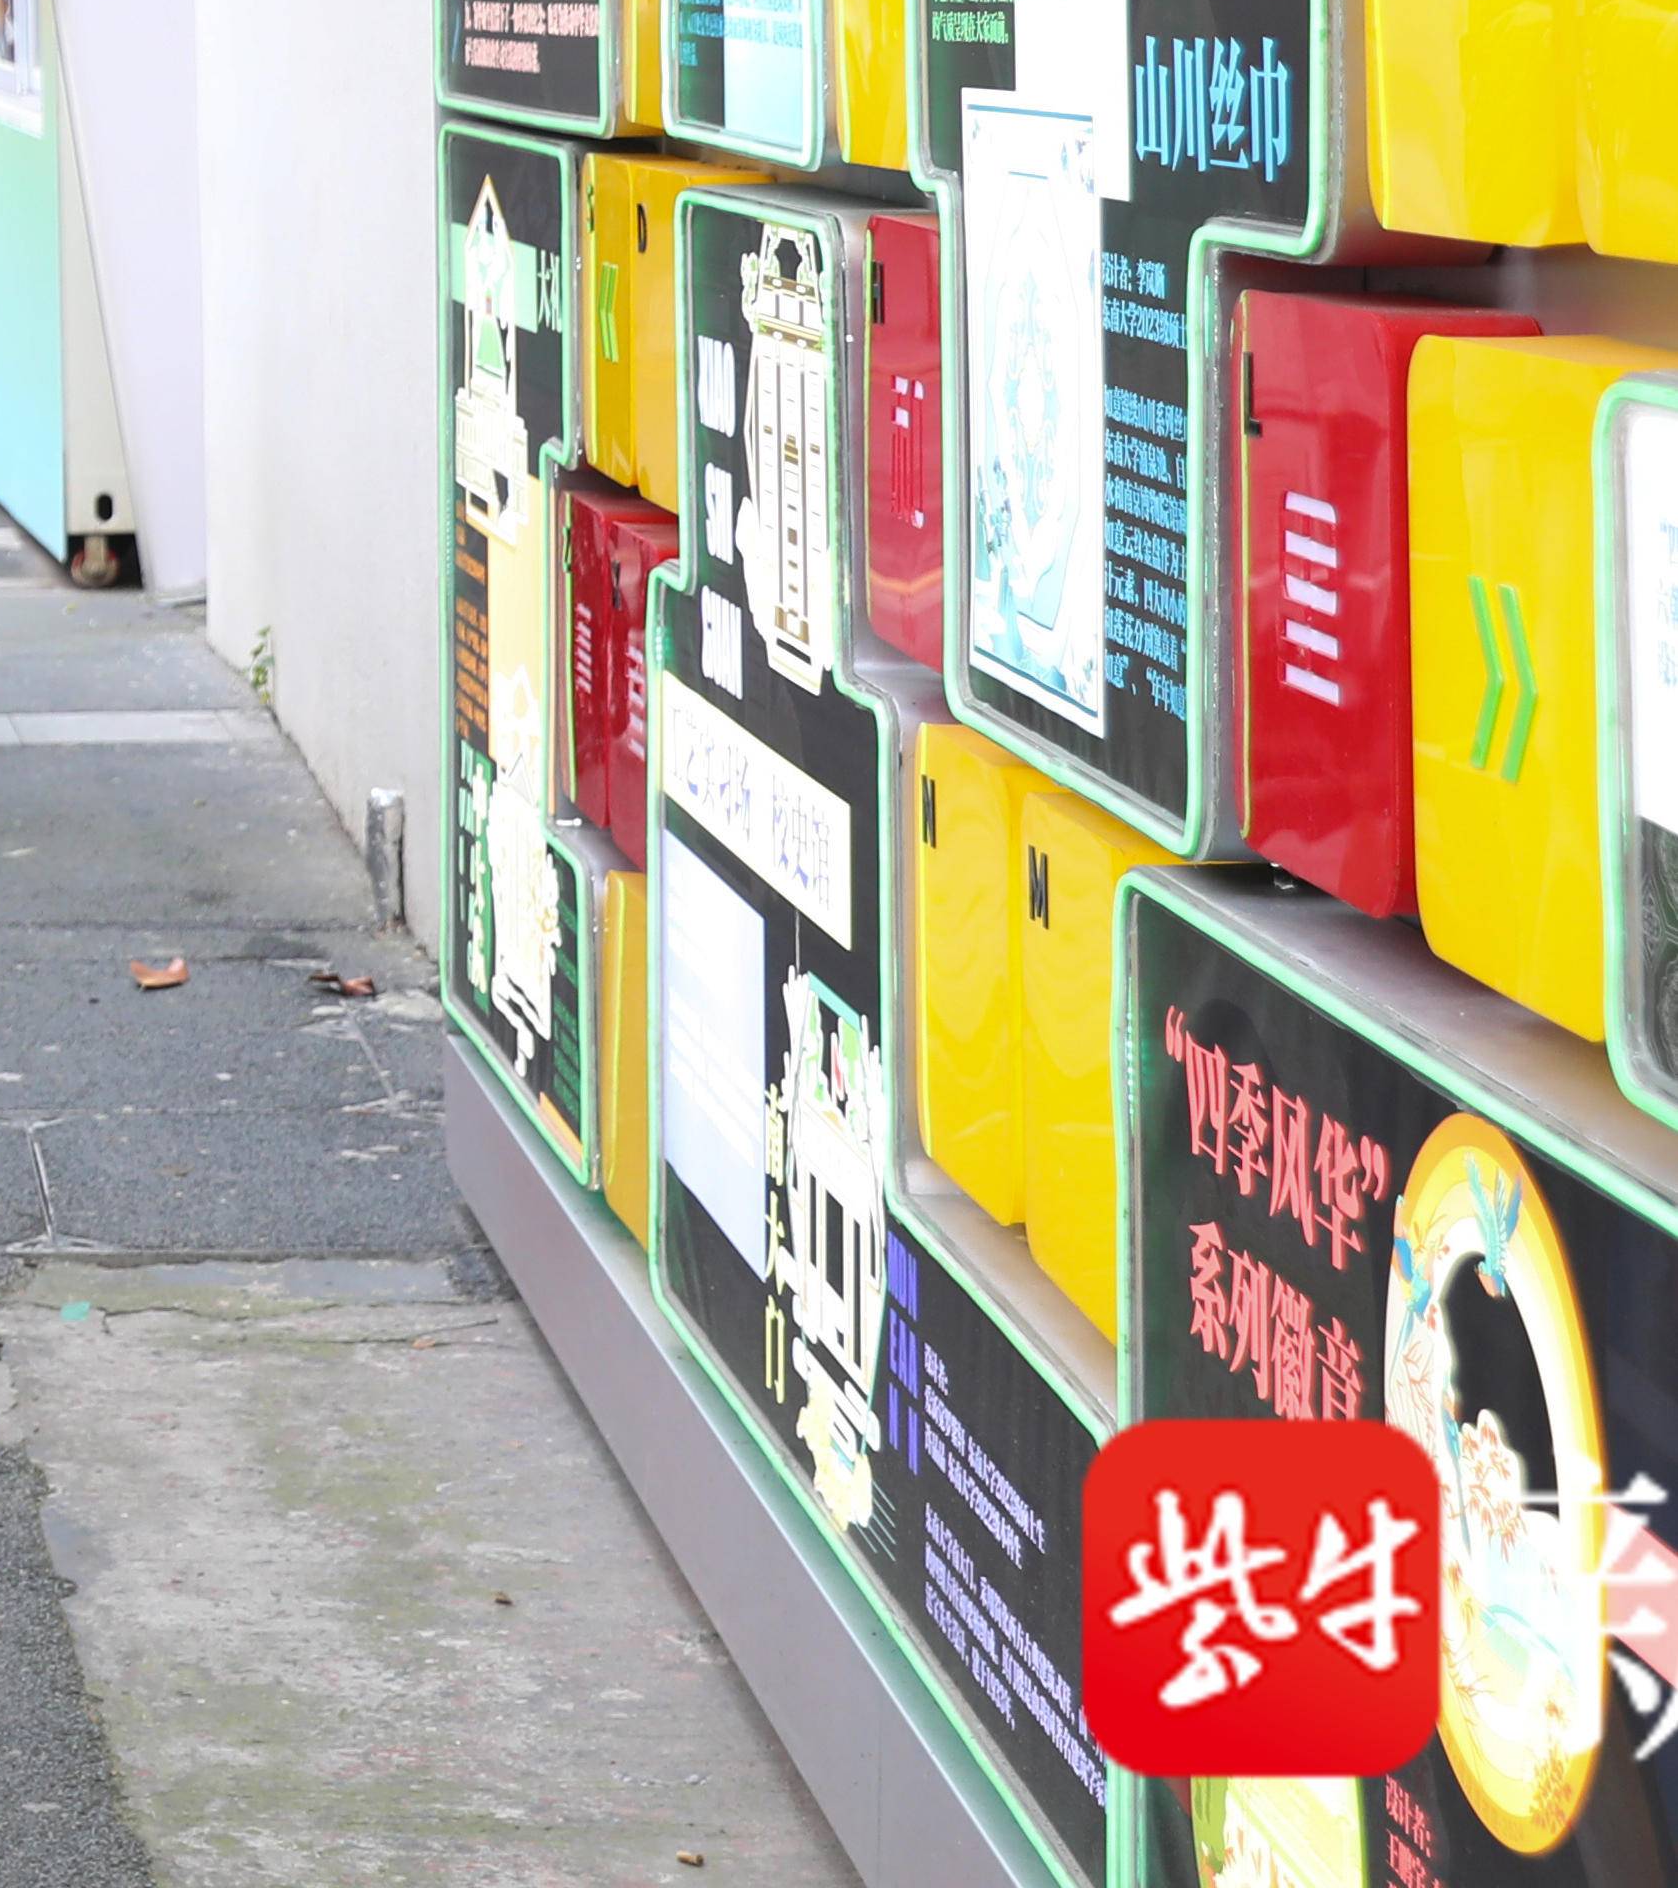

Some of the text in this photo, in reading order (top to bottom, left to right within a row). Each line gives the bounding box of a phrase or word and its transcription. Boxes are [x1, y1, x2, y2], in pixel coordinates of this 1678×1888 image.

[1132, 35, 1291, 184] 山川丝巾
[764, 1083, 786, 1405] 南大门
